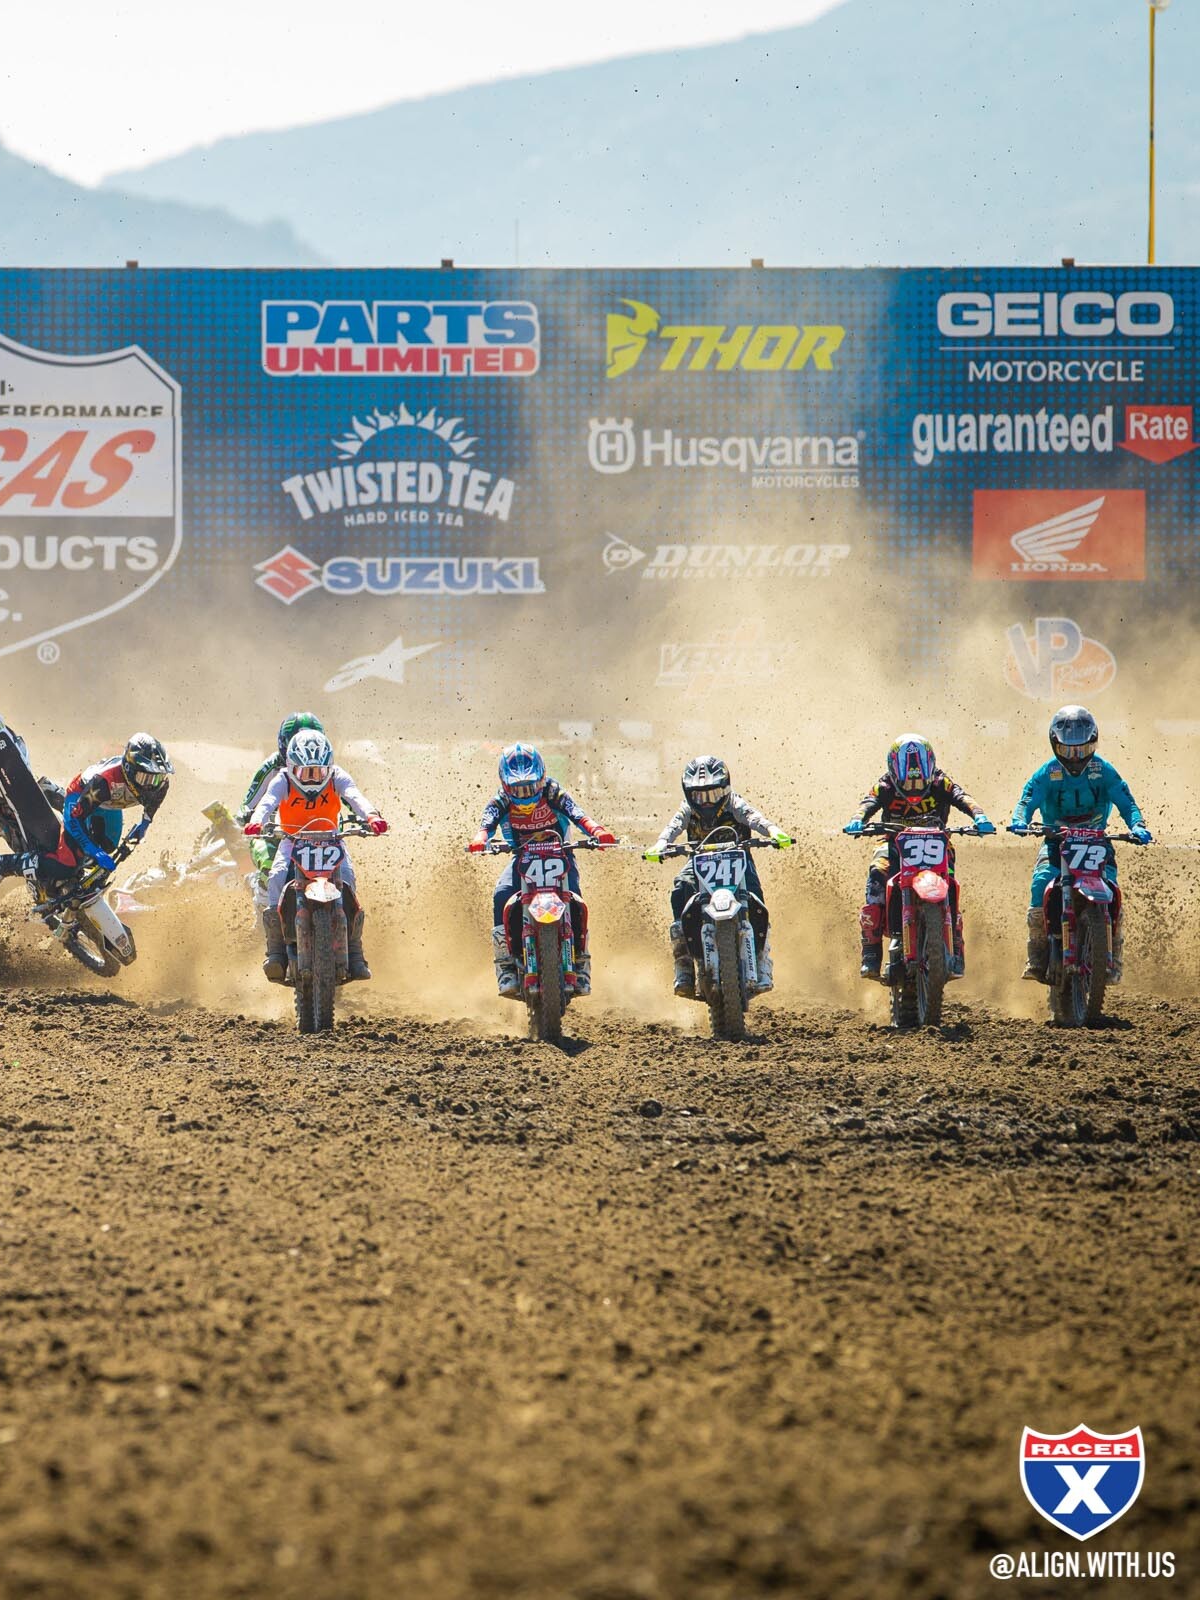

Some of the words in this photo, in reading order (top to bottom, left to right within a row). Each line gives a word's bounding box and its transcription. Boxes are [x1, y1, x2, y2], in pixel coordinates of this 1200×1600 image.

[264, 302, 538, 344] PARTS
[937, 291, 1175, 337] GEICO
[264, 346, 538, 373] UNLIMITED
[659, 325, 846, 371] THOR
[968, 360, 1145, 383] MOTORCYCLE
[912, 404, 1114, 467] guaranteed
[1128, 411, 1189, 441] Rate
[642, 428, 860, 473] Husqvarna
[281, 461, 444, 521] TWISTED
[448, 460, 516, 522] TEA
[751, 475, 860, 489] MOTORCYCLES
[344, 510, 388, 528] HARD
[394, 509, 429, 524] ICED
[436, 511, 464, 528] TEA
[648, 543, 851, 568] DUNLOP
[1010, 562, 1108, 573] HONDA
[324, 558, 539, 593] SUZUKI
[1006, 616, 1083, 700] VP
[290, 791, 330, 810] FOX
[1057, 785, 1103, 810] FLY
[296, 846, 341, 871] 112
[903, 838, 945, 867] 39
[1068, 843, 1107, 871] 73
[524, 858, 564, 888] 42
[700, 858, 743, 888] 241
